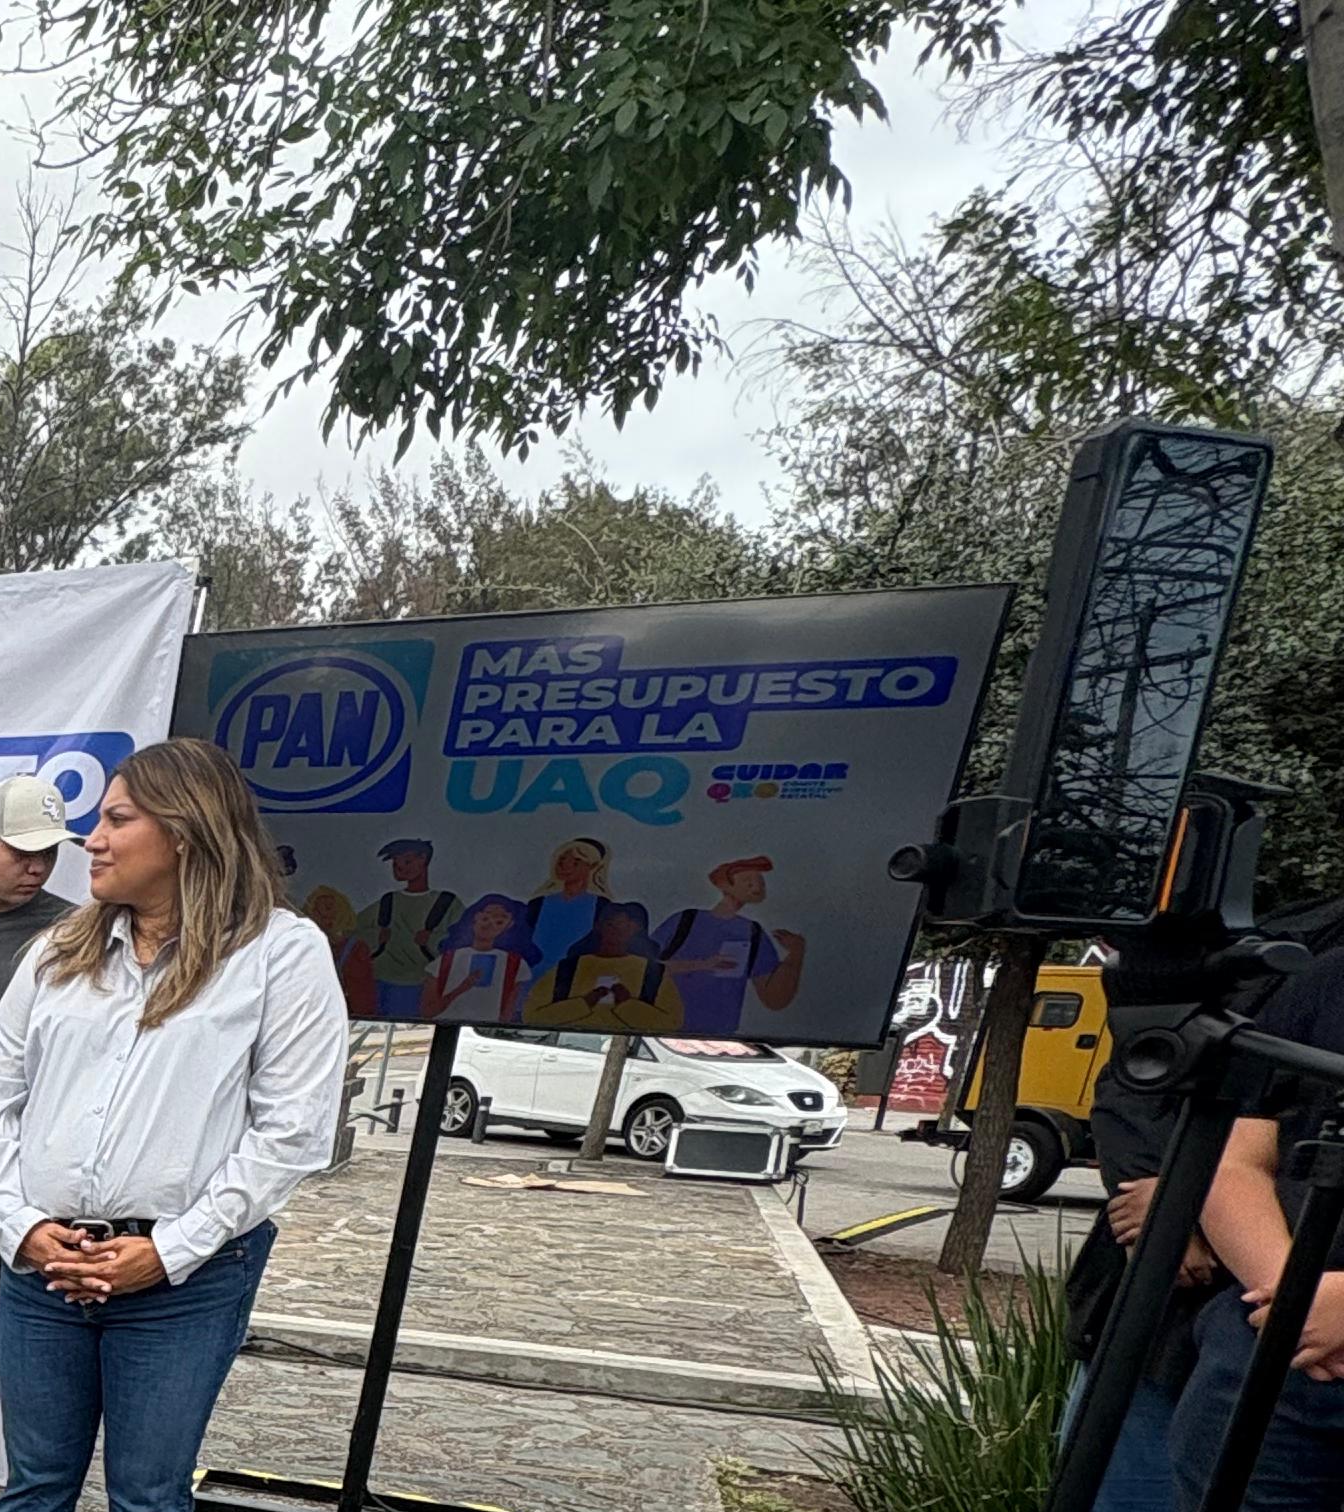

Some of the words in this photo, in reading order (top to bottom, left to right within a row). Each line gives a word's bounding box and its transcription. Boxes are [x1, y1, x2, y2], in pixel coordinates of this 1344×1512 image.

[462, 666, 936, 714] PRESUPUESTO
[240, 690, 381, 769] PAN
[455, 714, 622, 750] PARA
[639, 711, 723, 744] LA
[445, 755, 691, 826] UAQ
[711, 762, 849, 781] CUIDAR
